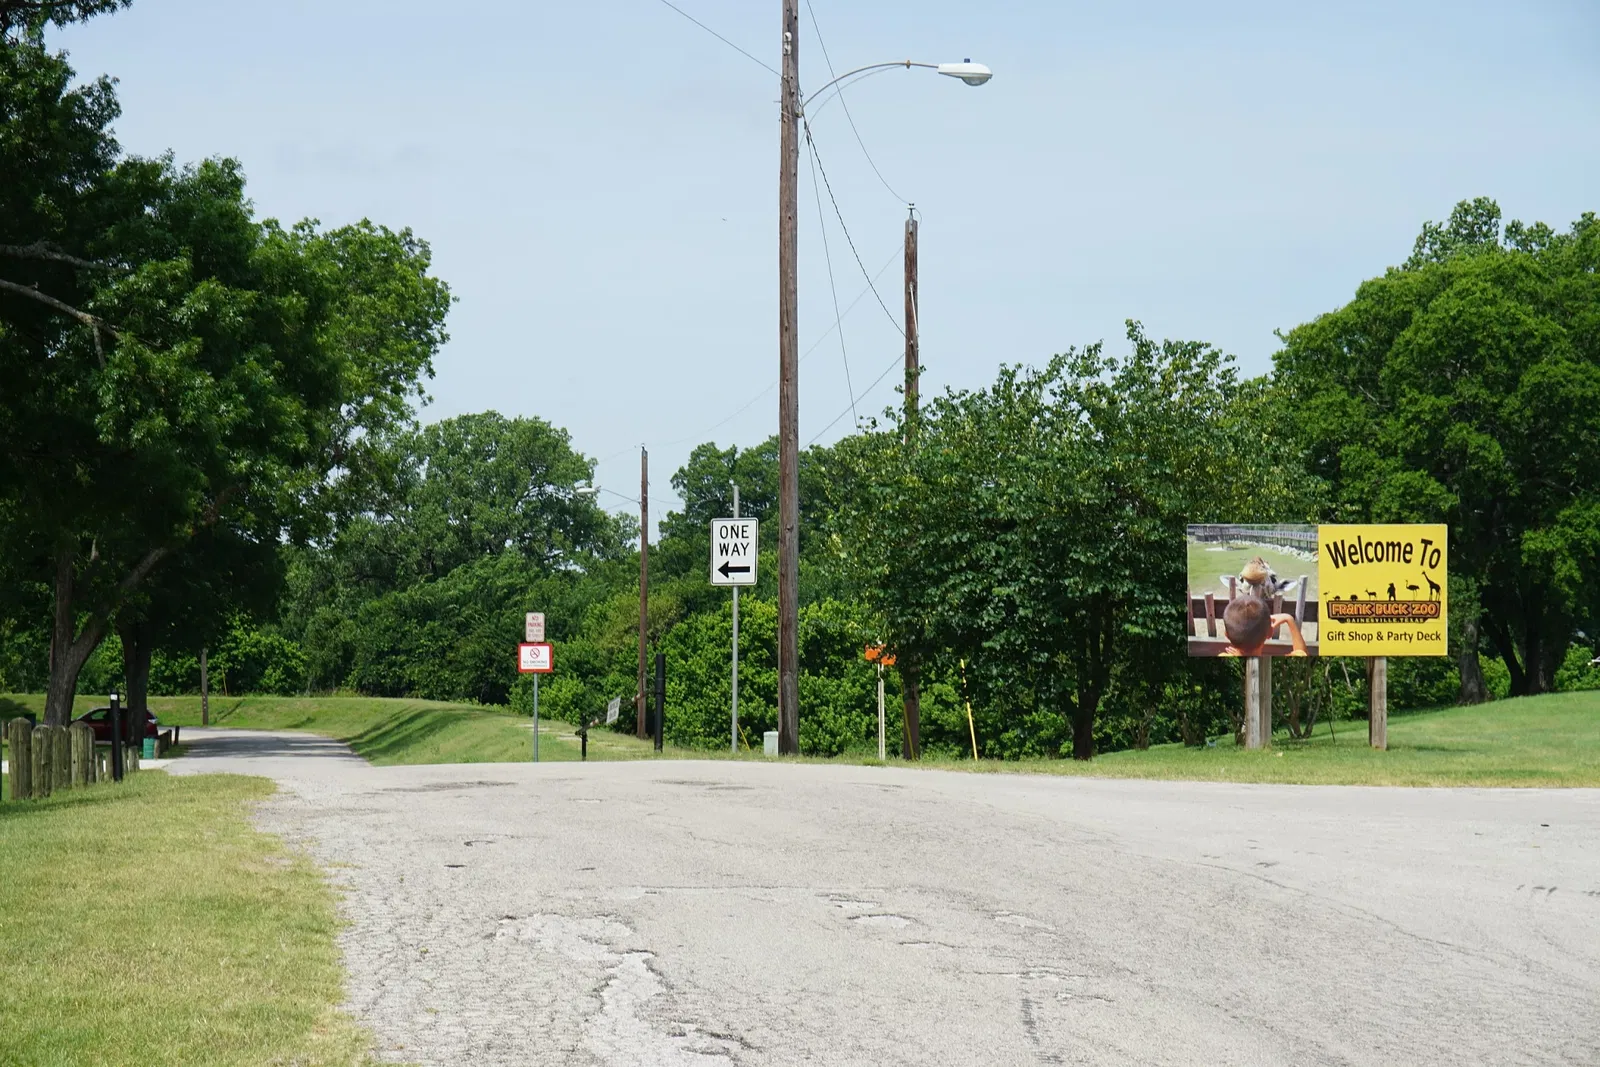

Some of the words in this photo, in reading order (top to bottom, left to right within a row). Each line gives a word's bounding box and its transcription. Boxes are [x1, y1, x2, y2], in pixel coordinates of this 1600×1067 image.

[720, 525, 749, 539] ONE
[719, 543, 749, 556] WAY
[1326, 536, 1413, 569] Welcome
[1419, 538, 1441, 569] To
[1411, 603, 1437, 615] ZOO
[1327, 631, 1345, 641] Gift
[1348, 631, 1373, 643] Shop
[1376, 631, 1384, 641] &
[1387, 631, 1413, 643] Party
[1417, 631, 1441, 641] Deck
